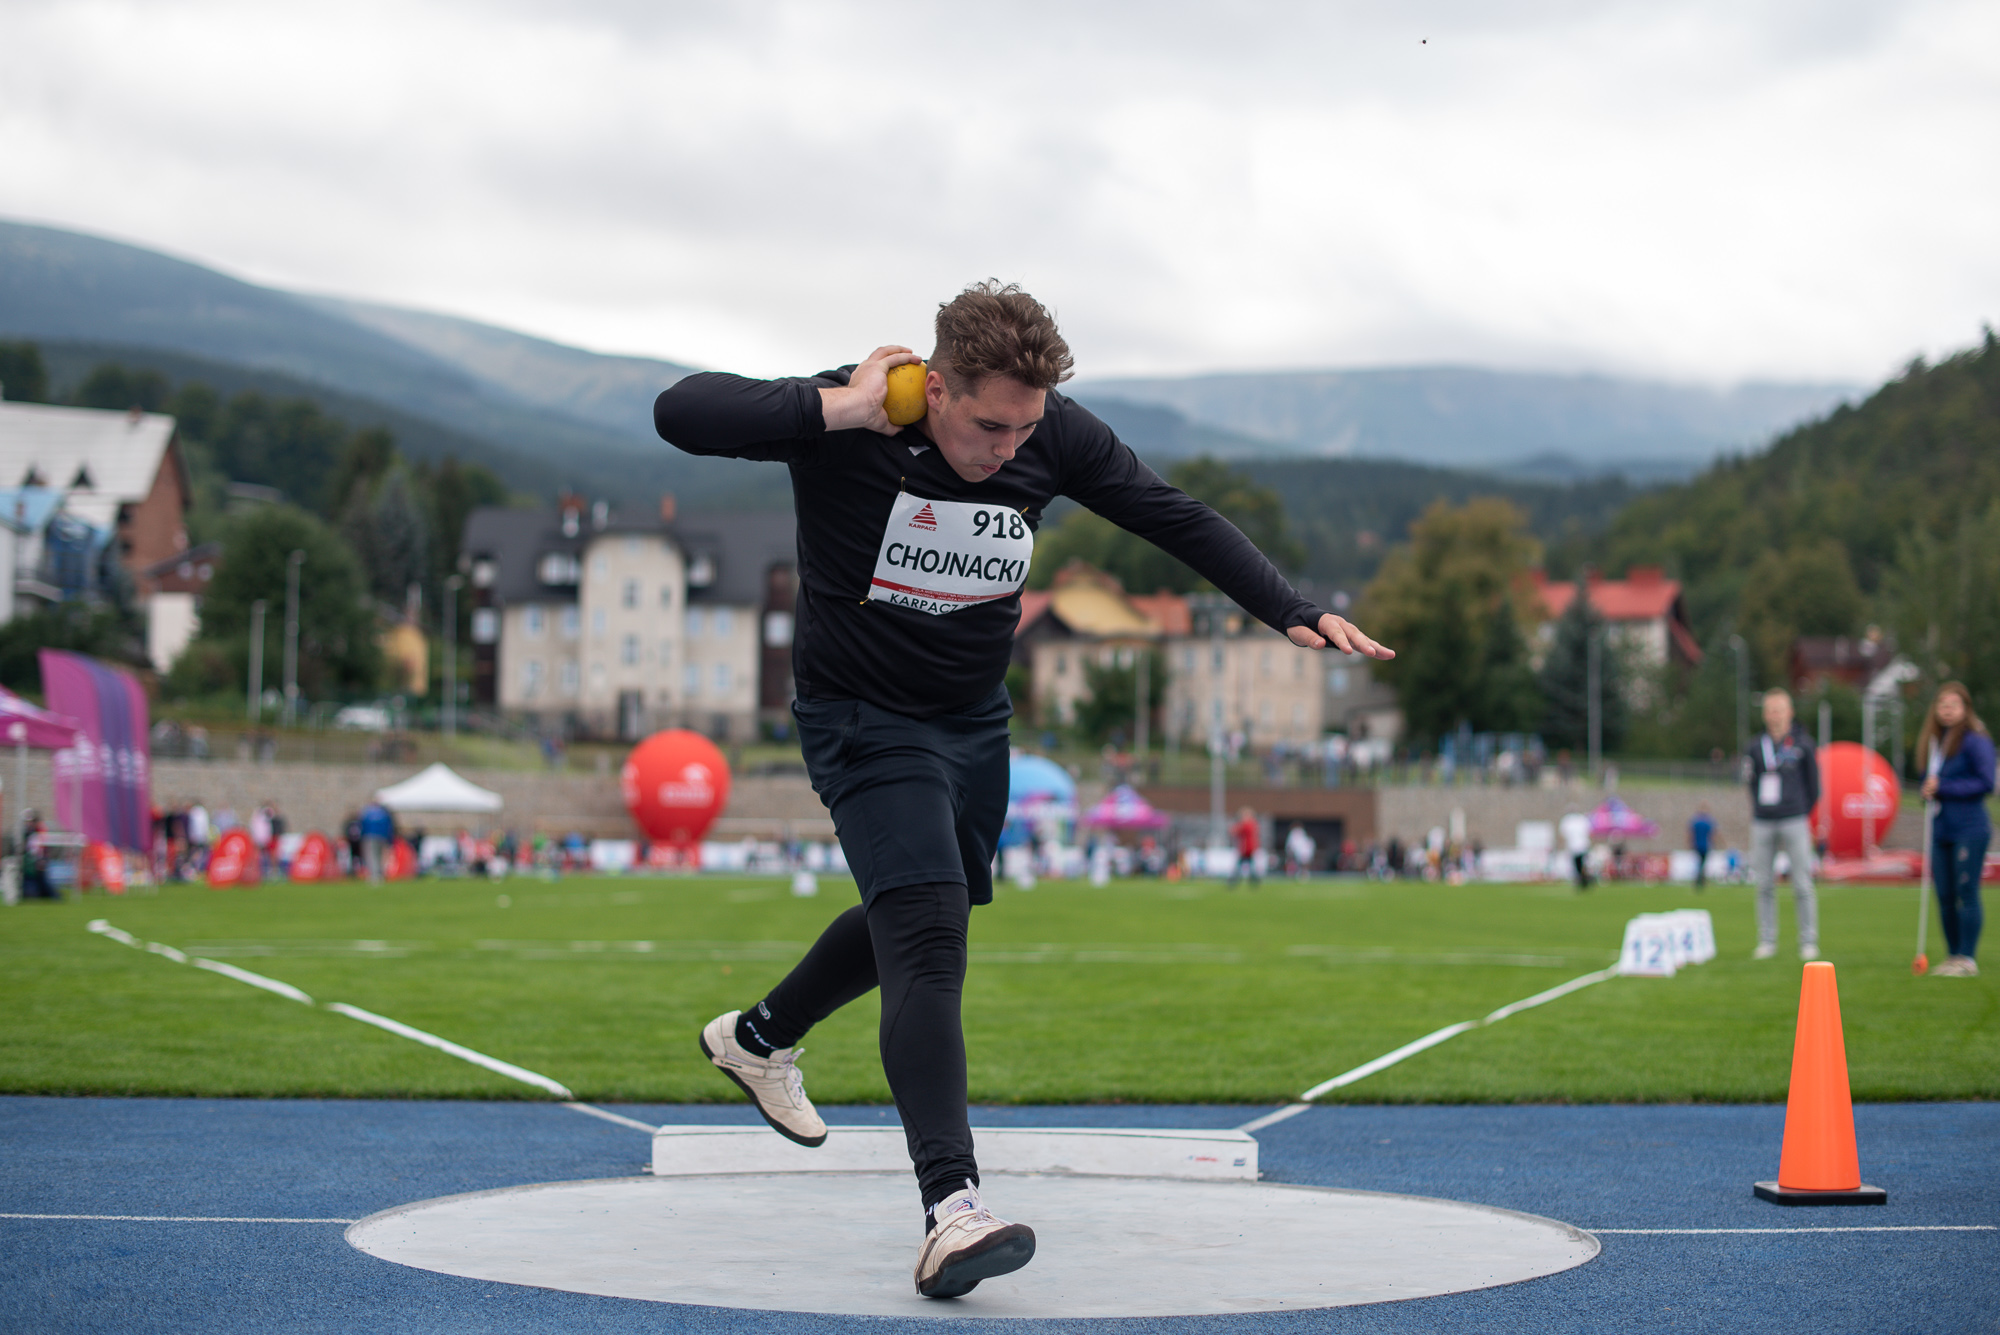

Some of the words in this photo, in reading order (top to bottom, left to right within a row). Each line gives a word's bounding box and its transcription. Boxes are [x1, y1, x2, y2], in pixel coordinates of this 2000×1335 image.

[908, 522, 937, 532] KARPACZ
[972, 510, 1025, 540] 918
[886, 542, 1025, 582] CHOJNACKI
[890, 593, 959, 614] KARPACZ
[1632, 936, 1665, 967] 12
